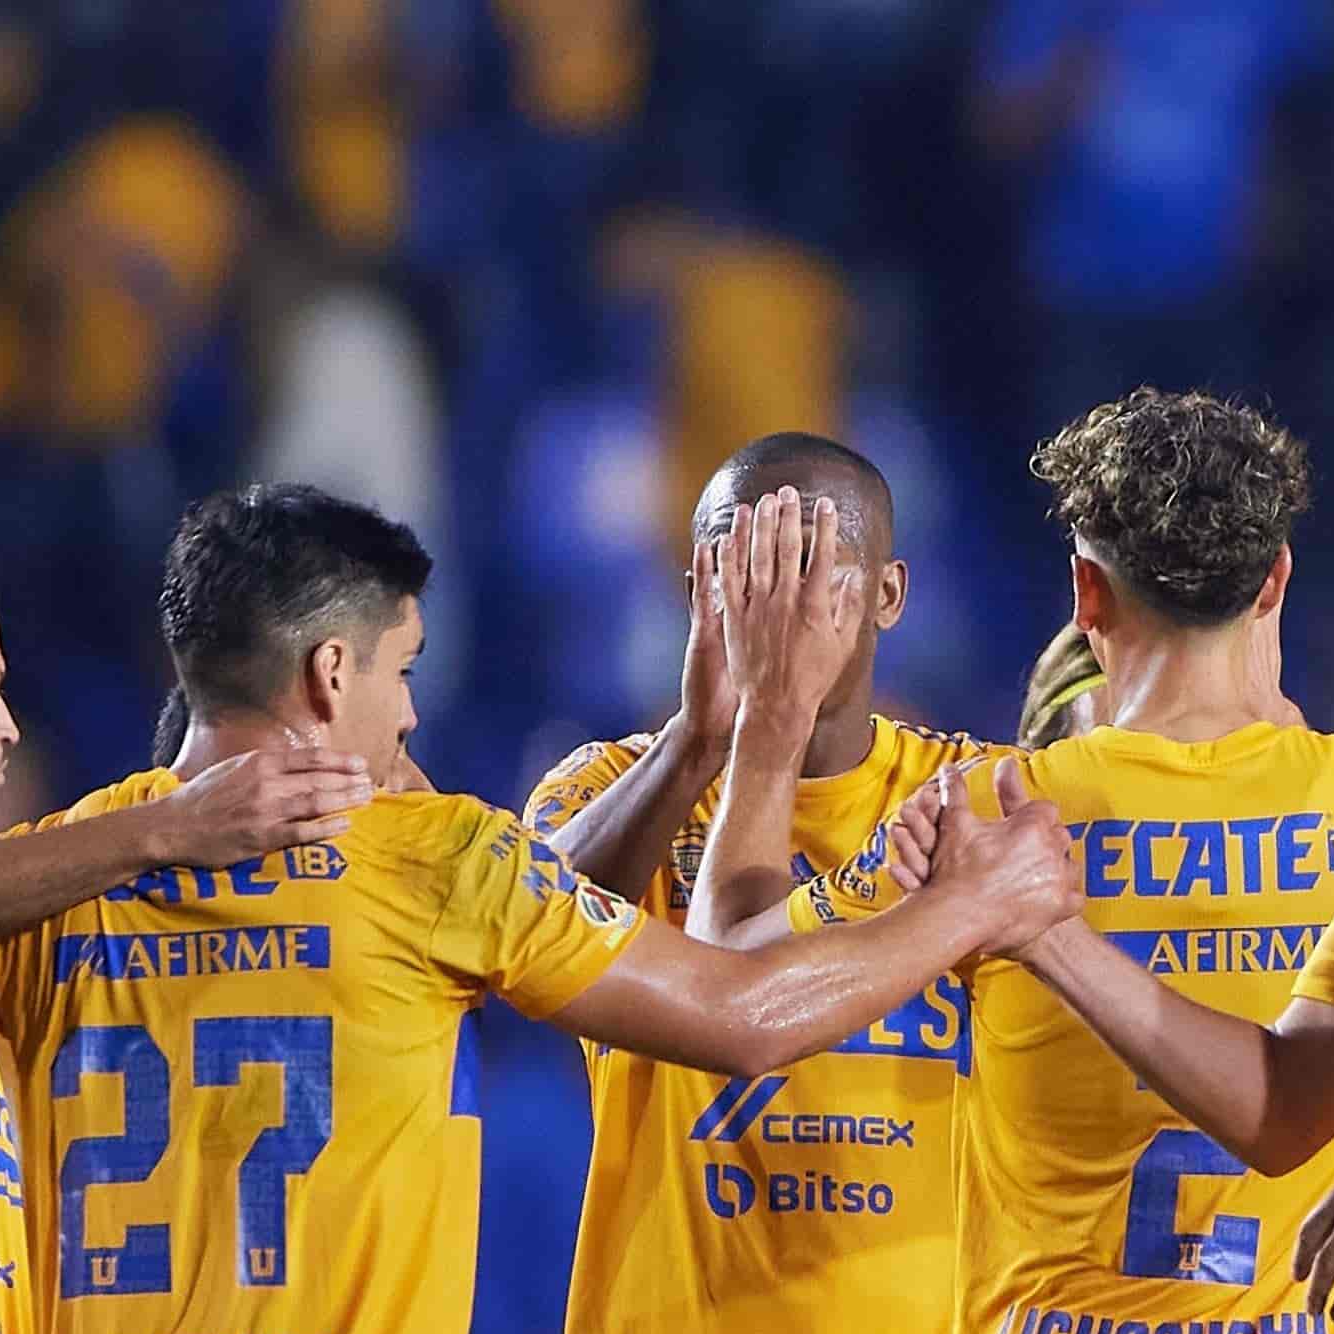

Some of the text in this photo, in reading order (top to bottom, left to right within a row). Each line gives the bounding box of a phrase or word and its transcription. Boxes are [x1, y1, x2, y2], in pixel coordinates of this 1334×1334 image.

[294, 843, 347, 876] 18+
[1067, 813, 1324, 898] ECATE
[123, 926, 309, 978] AFIRME
[1148, 924, 1329, 974] AFIRM
[762, 1112, 915, 1148] CEMEX
[50, 1014, 335, 1299] 27
[769, 1170, 894, 1215] Bitso
